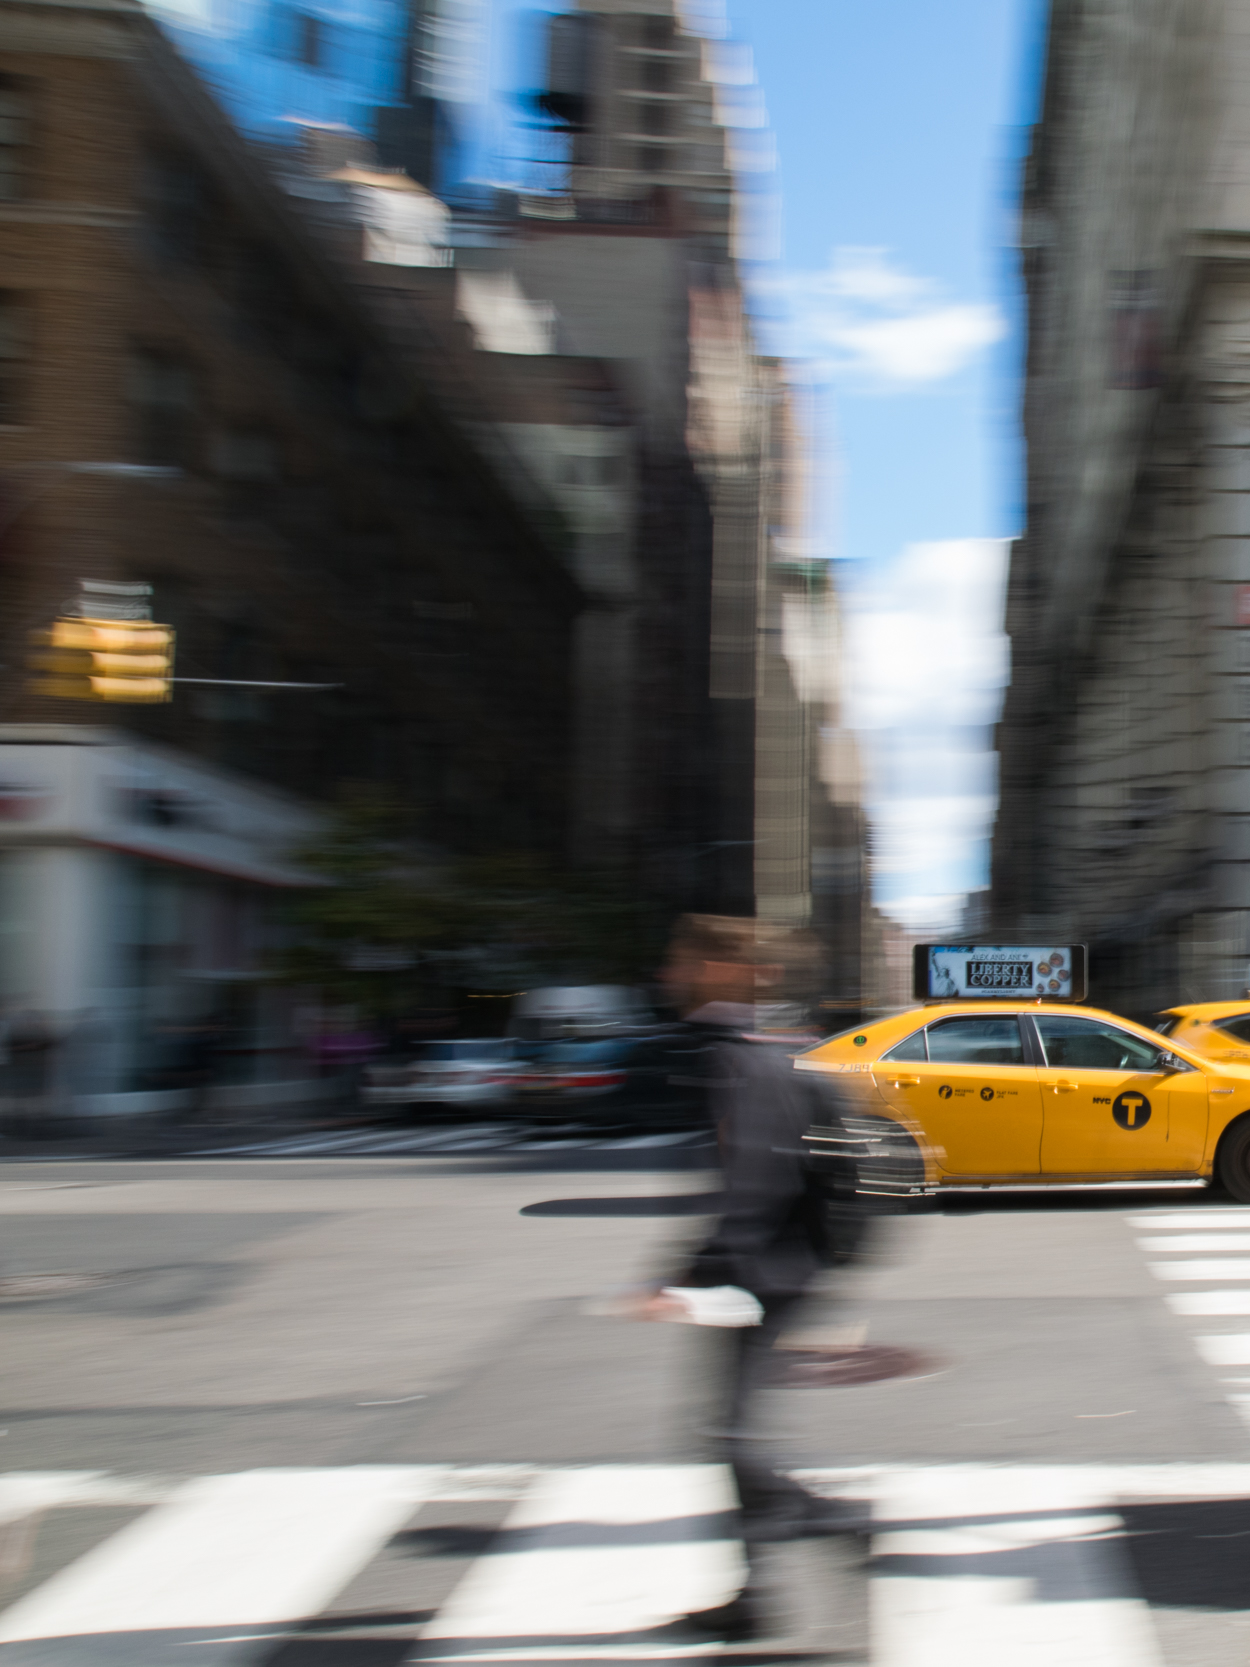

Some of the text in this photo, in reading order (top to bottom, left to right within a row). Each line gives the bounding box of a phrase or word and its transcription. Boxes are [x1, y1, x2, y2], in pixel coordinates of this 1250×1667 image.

[971, 963, 1030, 976] LIBERTY
[971, 974, 1029, 987] COPPER
[1092, 1097, 1143, 1126] NYC T
